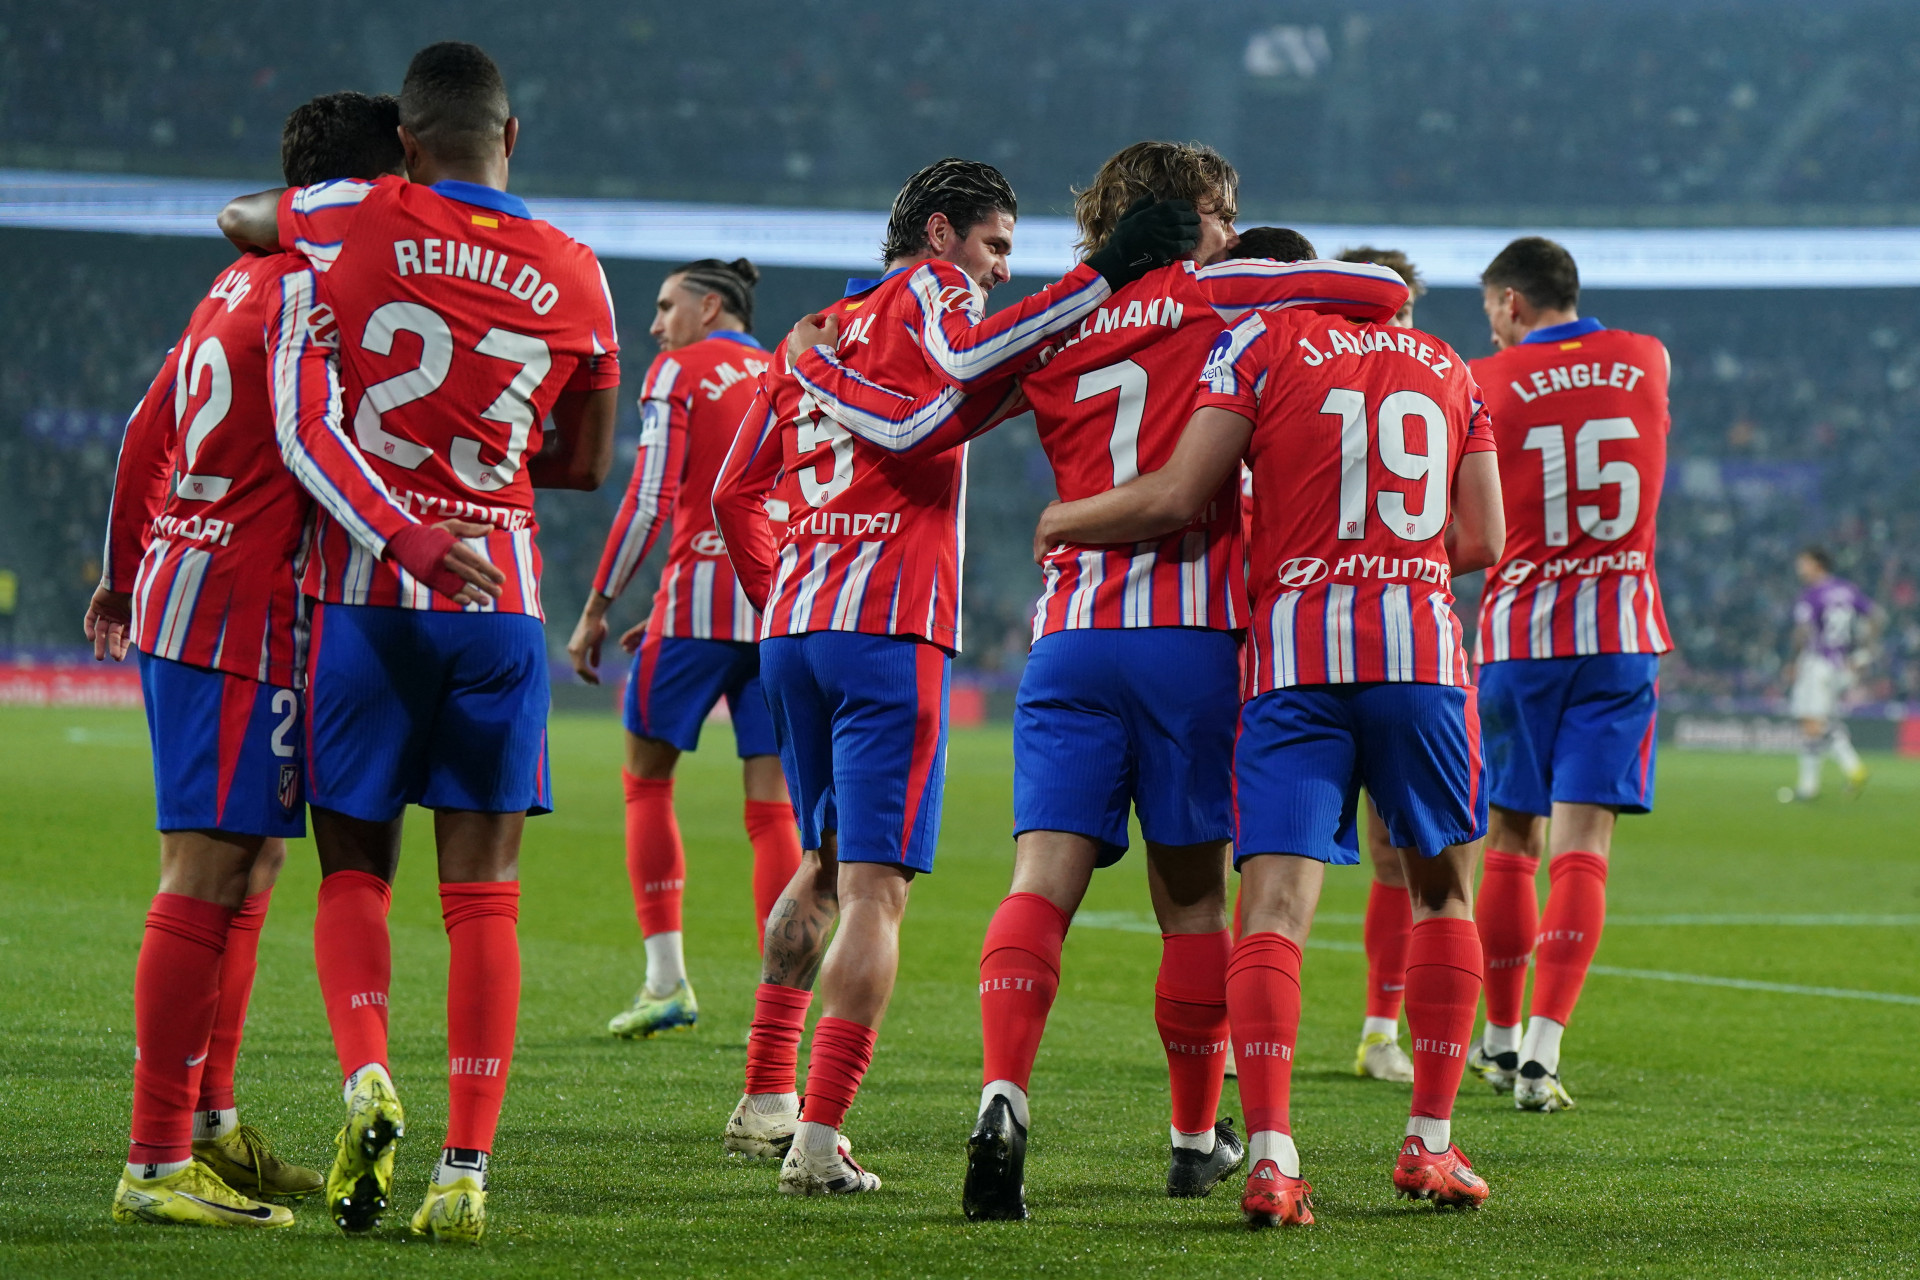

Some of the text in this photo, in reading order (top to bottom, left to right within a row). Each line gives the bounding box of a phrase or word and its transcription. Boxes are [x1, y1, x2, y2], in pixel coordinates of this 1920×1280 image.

[394, 239, 560, 316] REINILDO
[354, 302, 552, 492] 23
[1511, 362, 1645, 403] LENGLET
[793, 391, 855, 508] 5
[1074, 359, 1149, 488] 7
[1319, 388, 1449, 541] 19
[1522, 417, 1640, 547] 15
[1543, 551, 1647, 579] HYUNDAI
[271, 689, 297, 757] 2
[451, 1057, 501, 1077] ATLETI
[1168, 1040, 1226, 1056] ATLETI
[1245, 1042, 1292, 1062] ATLETI
[1415, 1038, 1462, 1058] ATLETI
